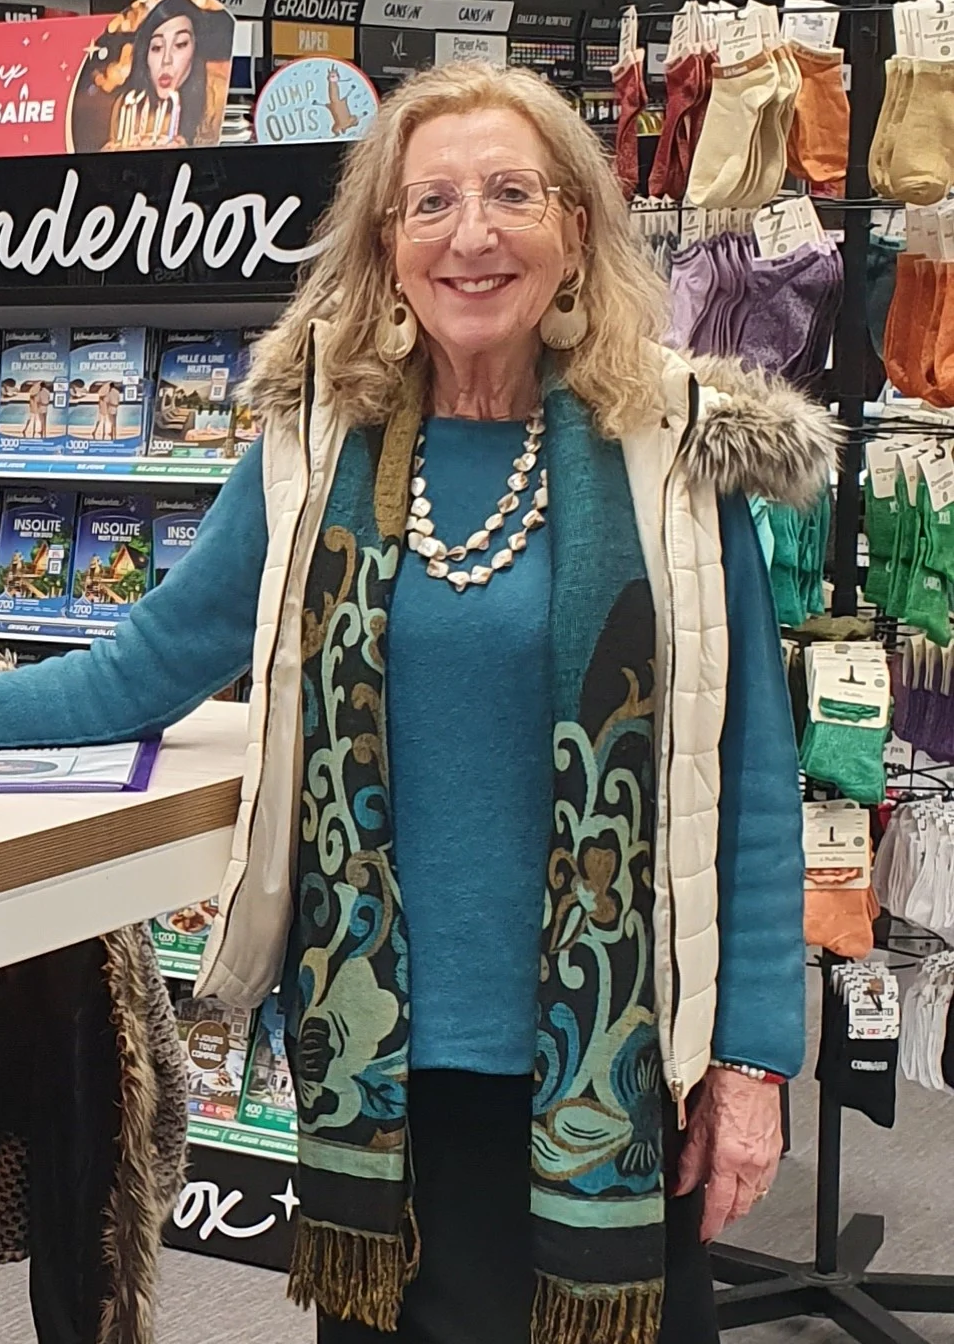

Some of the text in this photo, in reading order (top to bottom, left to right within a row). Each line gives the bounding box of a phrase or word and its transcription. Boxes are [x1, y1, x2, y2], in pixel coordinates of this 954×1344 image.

[384, 3, 423, 20] CANSON
[458, 7, 495, 22] CANSON
[298, 30, 329, 51] PAPER
[266, 79, 315, 112] JUMP
[265, 107, 320, 142] OUTS
[88, 351, 127, 360] WEEK-END
[14, 518, 62, 532] INSOLITE
[92, 522, 141, 536] INSOLITE
[168, 526, 197, 539] INSO
